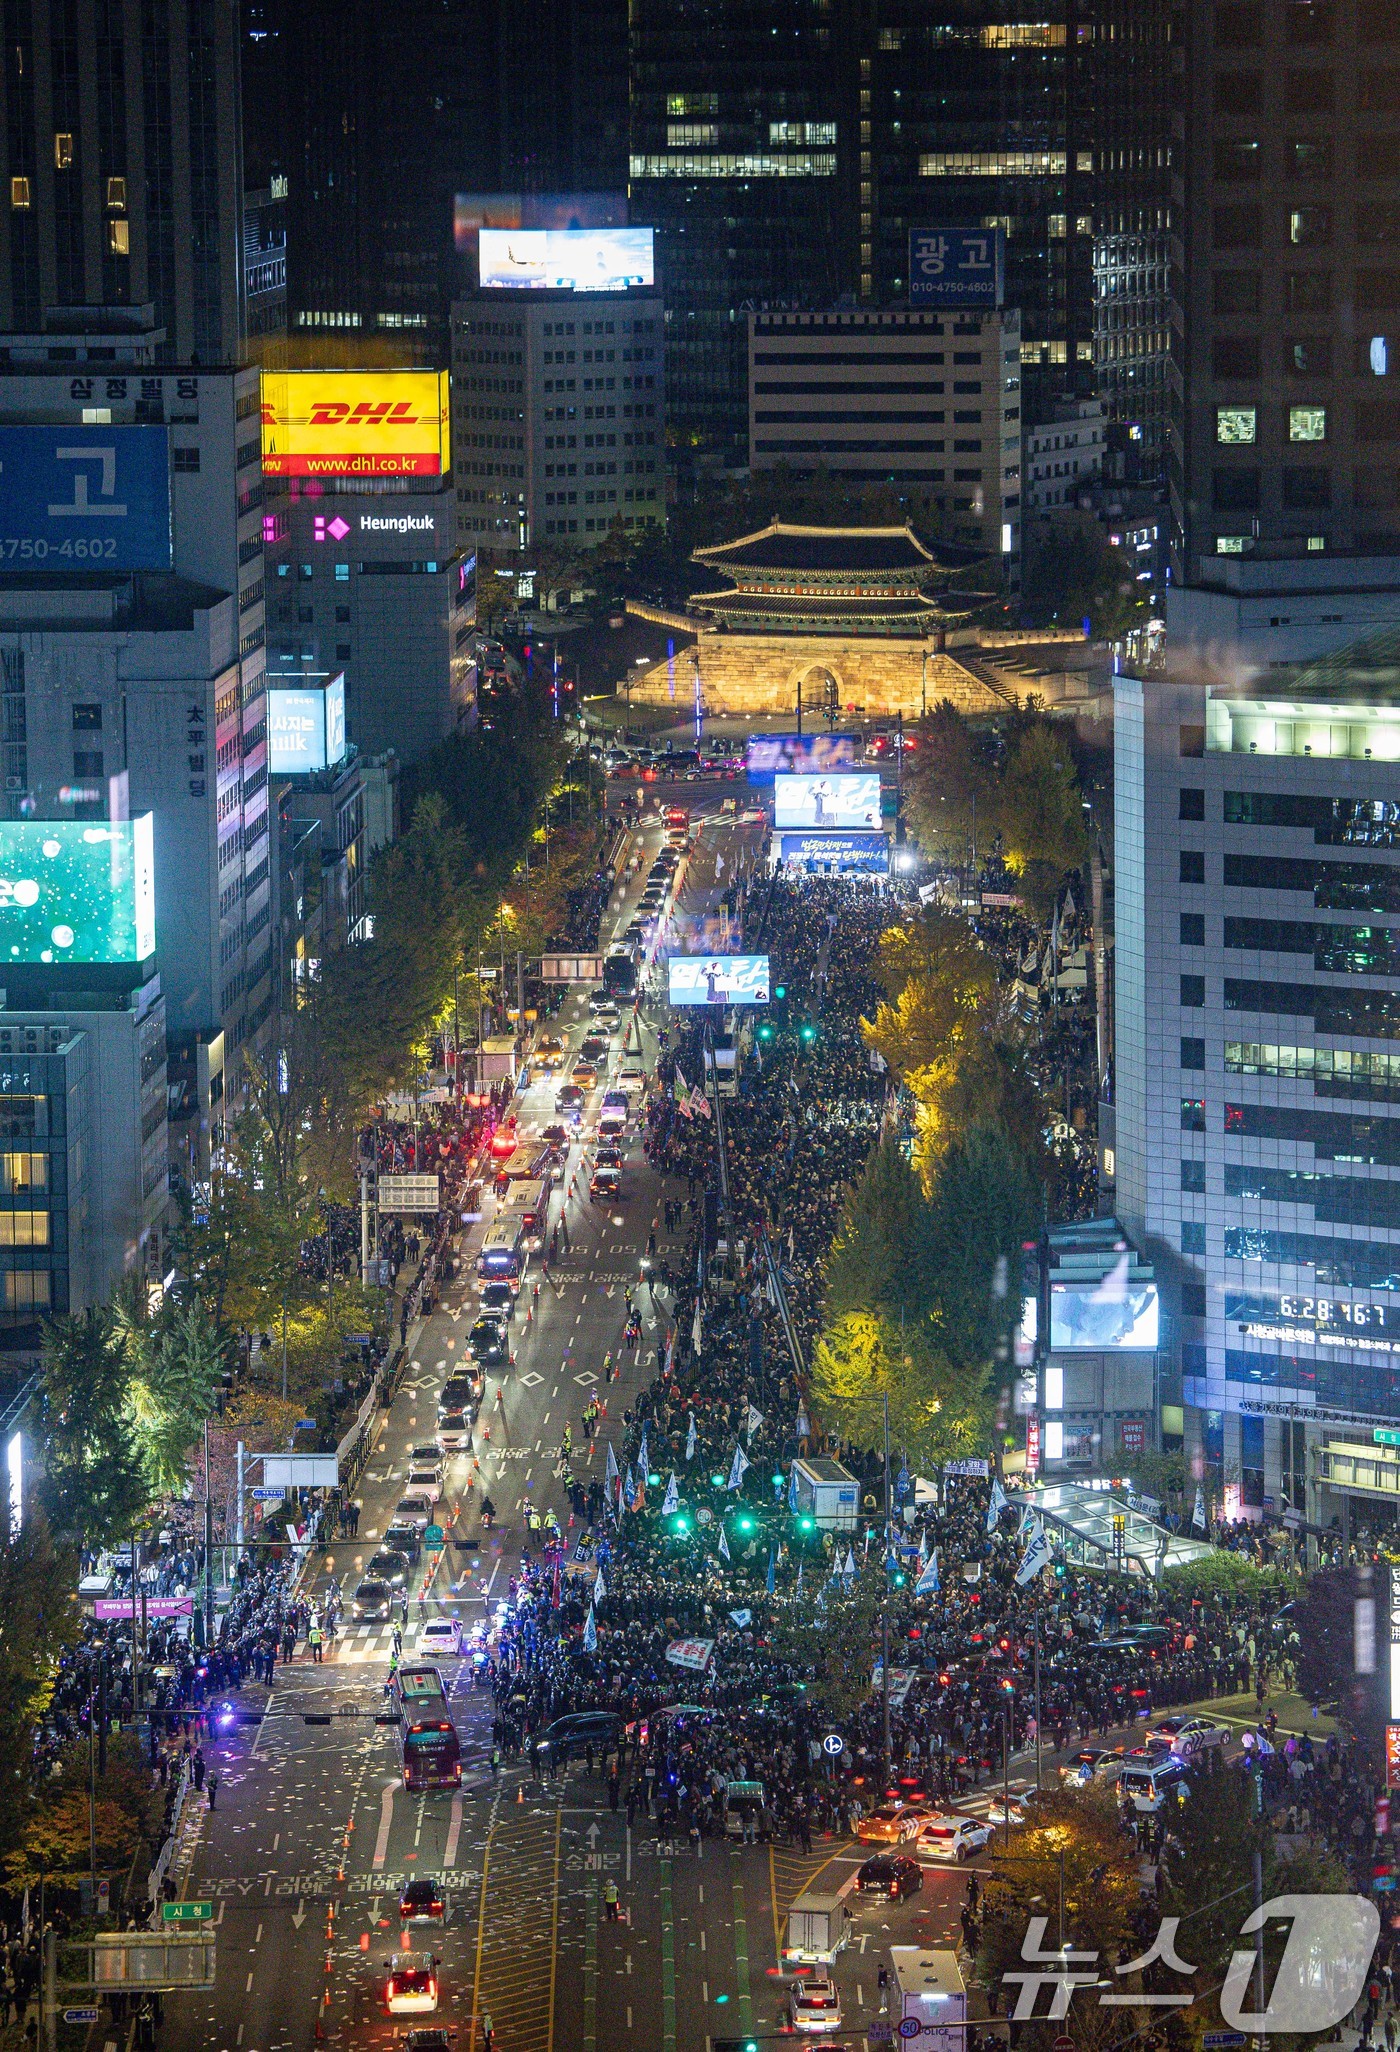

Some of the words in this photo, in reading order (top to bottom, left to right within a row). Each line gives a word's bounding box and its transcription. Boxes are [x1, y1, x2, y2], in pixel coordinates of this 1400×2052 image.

[915, 236, 991, 274] 광고
[912, 282, 994, 292] 010-4750-4602
[70, 378, 199, 400] 삼정빌딩
[308, 402, 419, 425] DHL
[307, 457, 418, 471] www.dhl.co.kr
[360, 515, 434, 533] Heungkuk
[0, 538, 118, 559] 750-4602
[565, 1853, 621, 1871] 숭례문
[173, 1906, 202, 1917] 시청
[902, 2021, 917, 2034] 50
